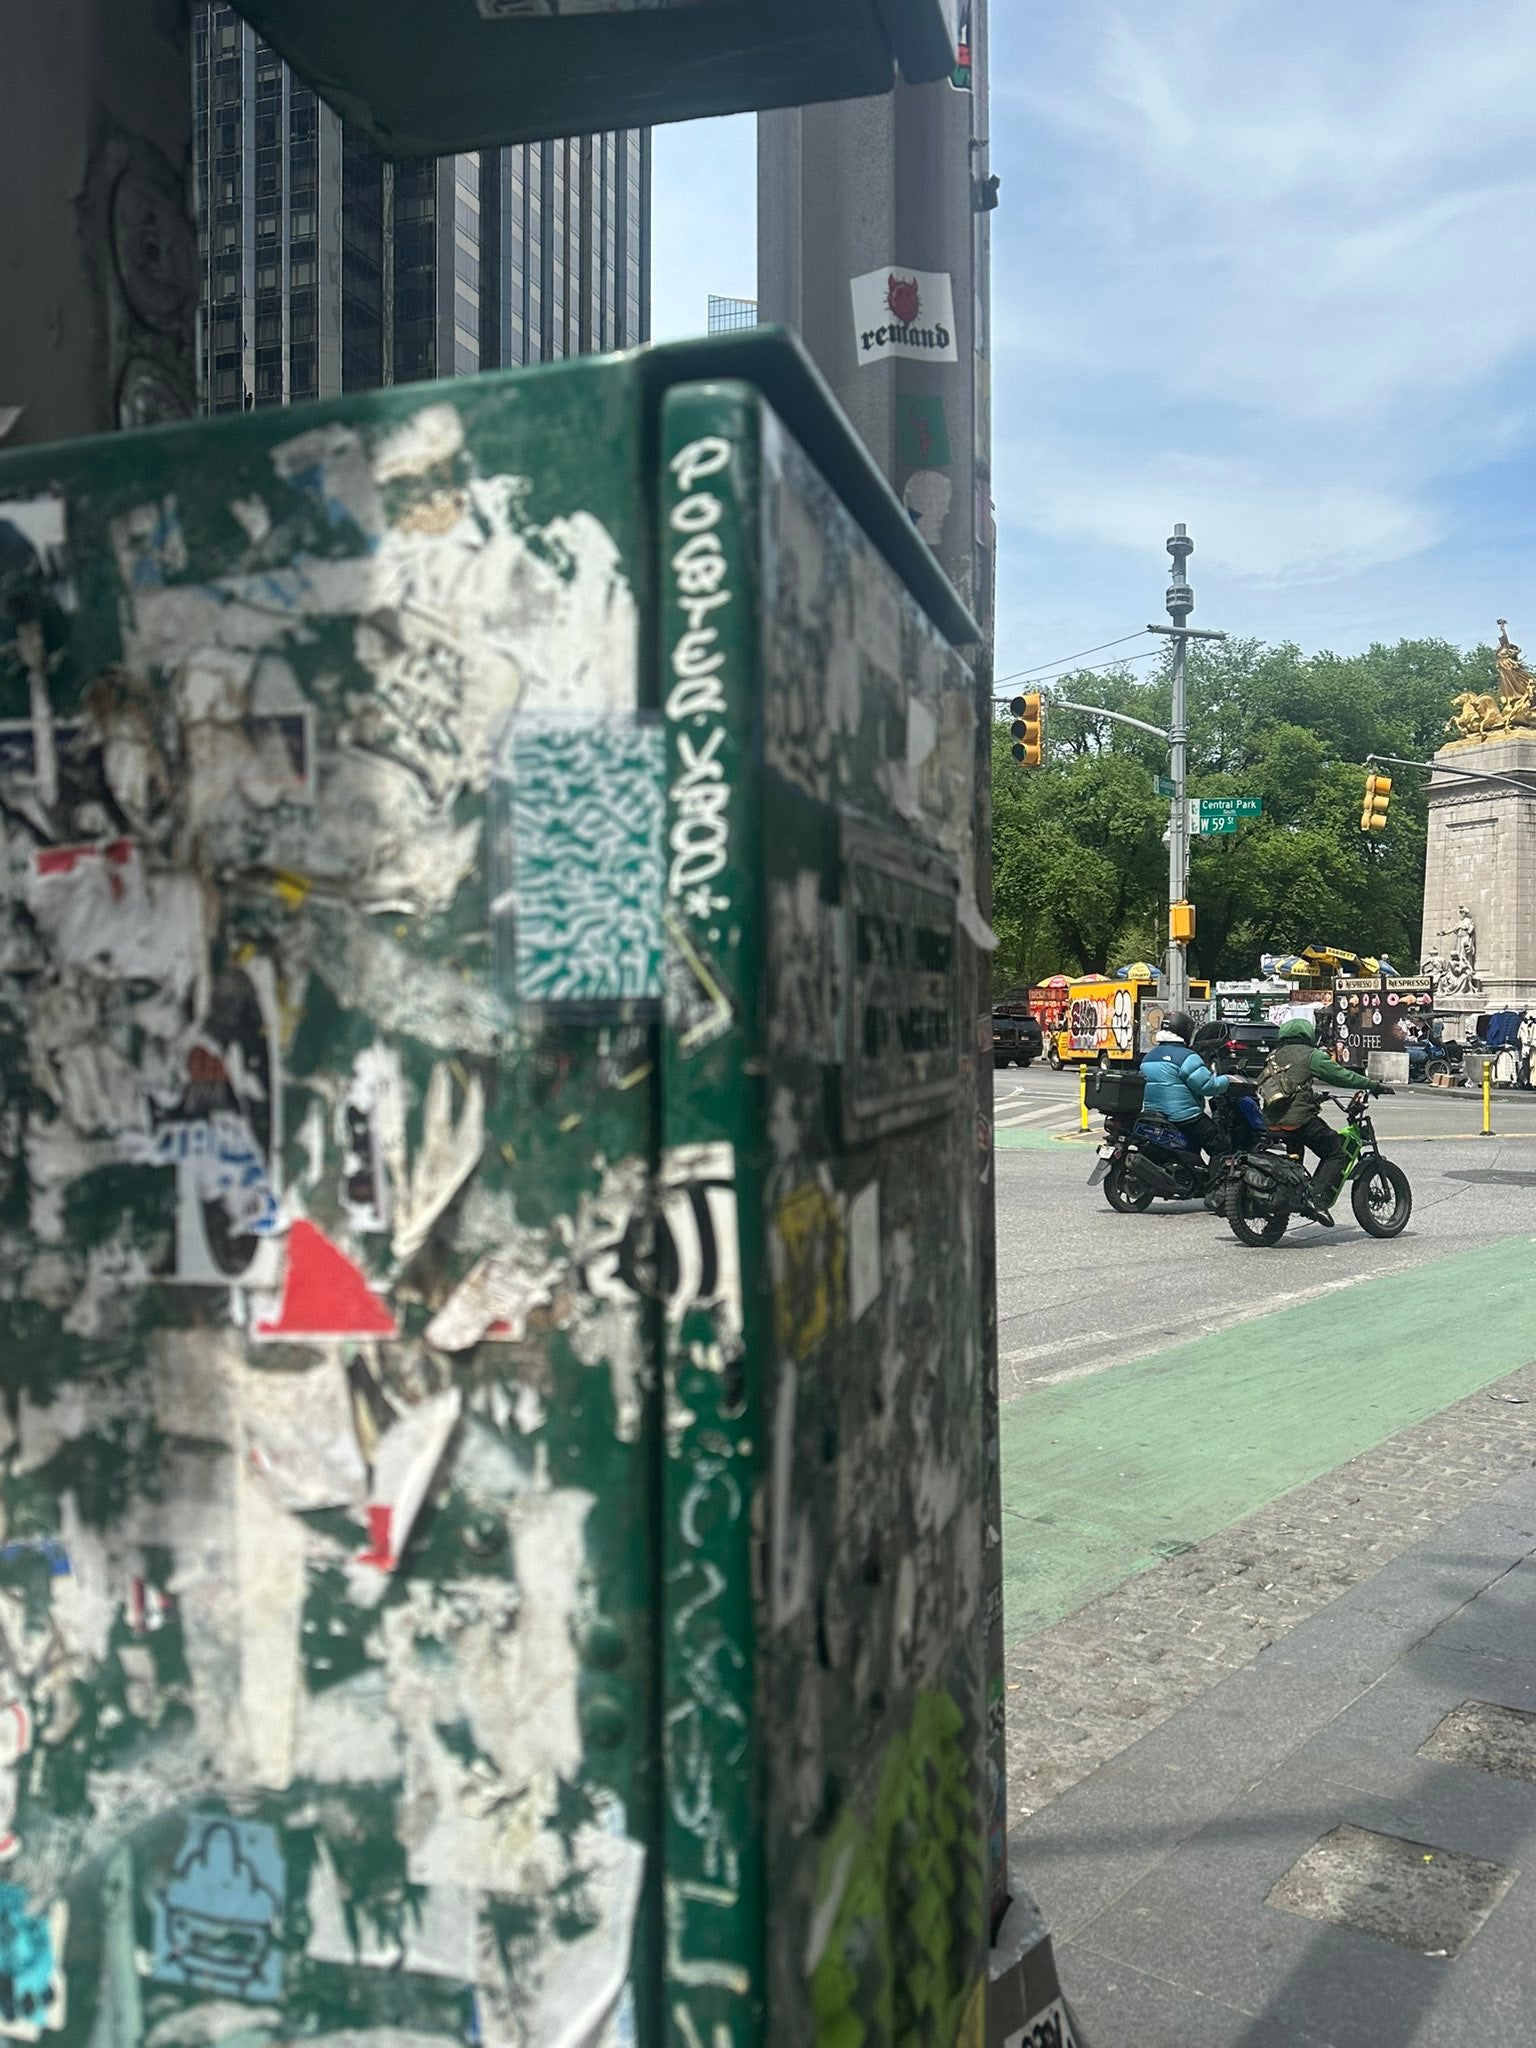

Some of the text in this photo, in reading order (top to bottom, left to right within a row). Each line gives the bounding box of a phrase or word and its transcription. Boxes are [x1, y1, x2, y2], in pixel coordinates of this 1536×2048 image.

[861, 322, 950, 350] remand
[1202, 799, 1256, 810] Central Park
[1201, 818, 1209, 831] W
[1212, 818, 1225, 831] 59
[1345, 980, 1372, 989] NESPRESSO
[1388, 979, 1430, 988] NESPRESSO
